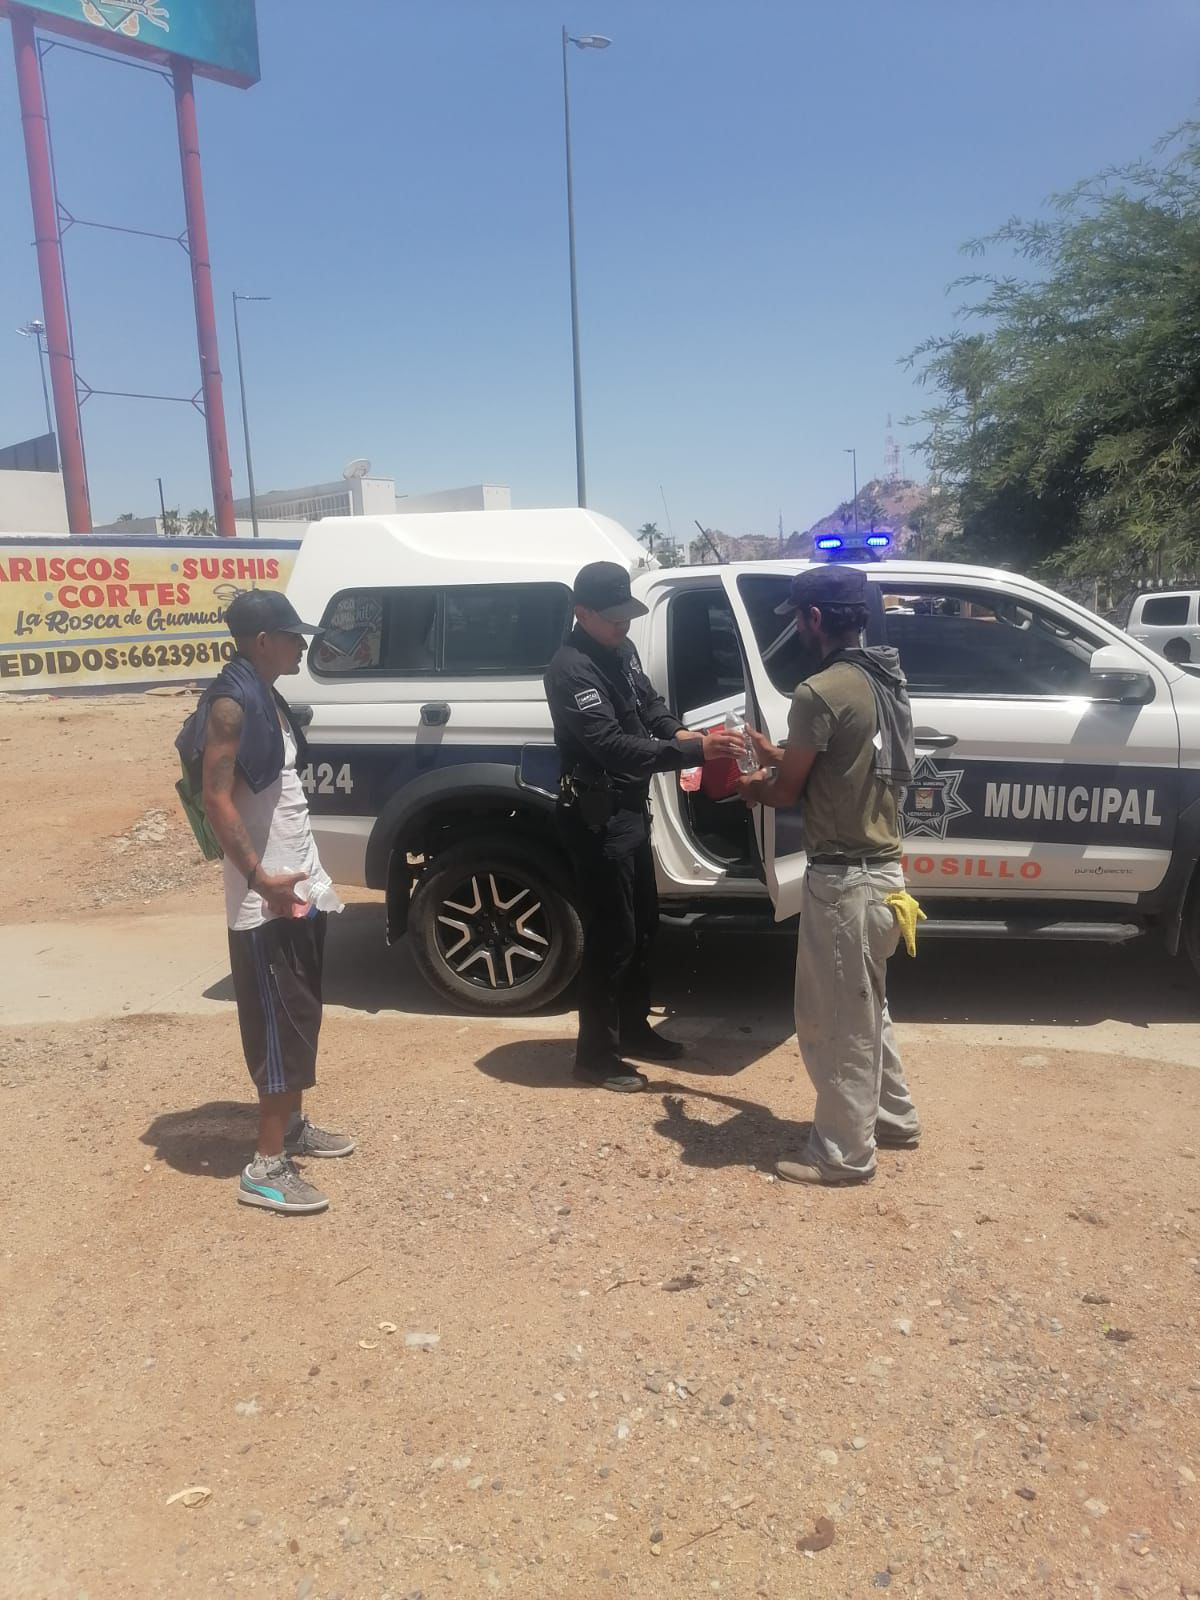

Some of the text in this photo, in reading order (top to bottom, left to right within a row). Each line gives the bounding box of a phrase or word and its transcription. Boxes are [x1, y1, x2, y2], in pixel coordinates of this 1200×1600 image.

[182, 558, 279, 580] SUSHIS
[57, 583, 191, 609] CORTES
[14, 610, 42, 636] La
[44, 610, 122, 634] Rosca
[124, 609, 142, 625] de
[984, 782, 1162, 826] MUNICIPAL
